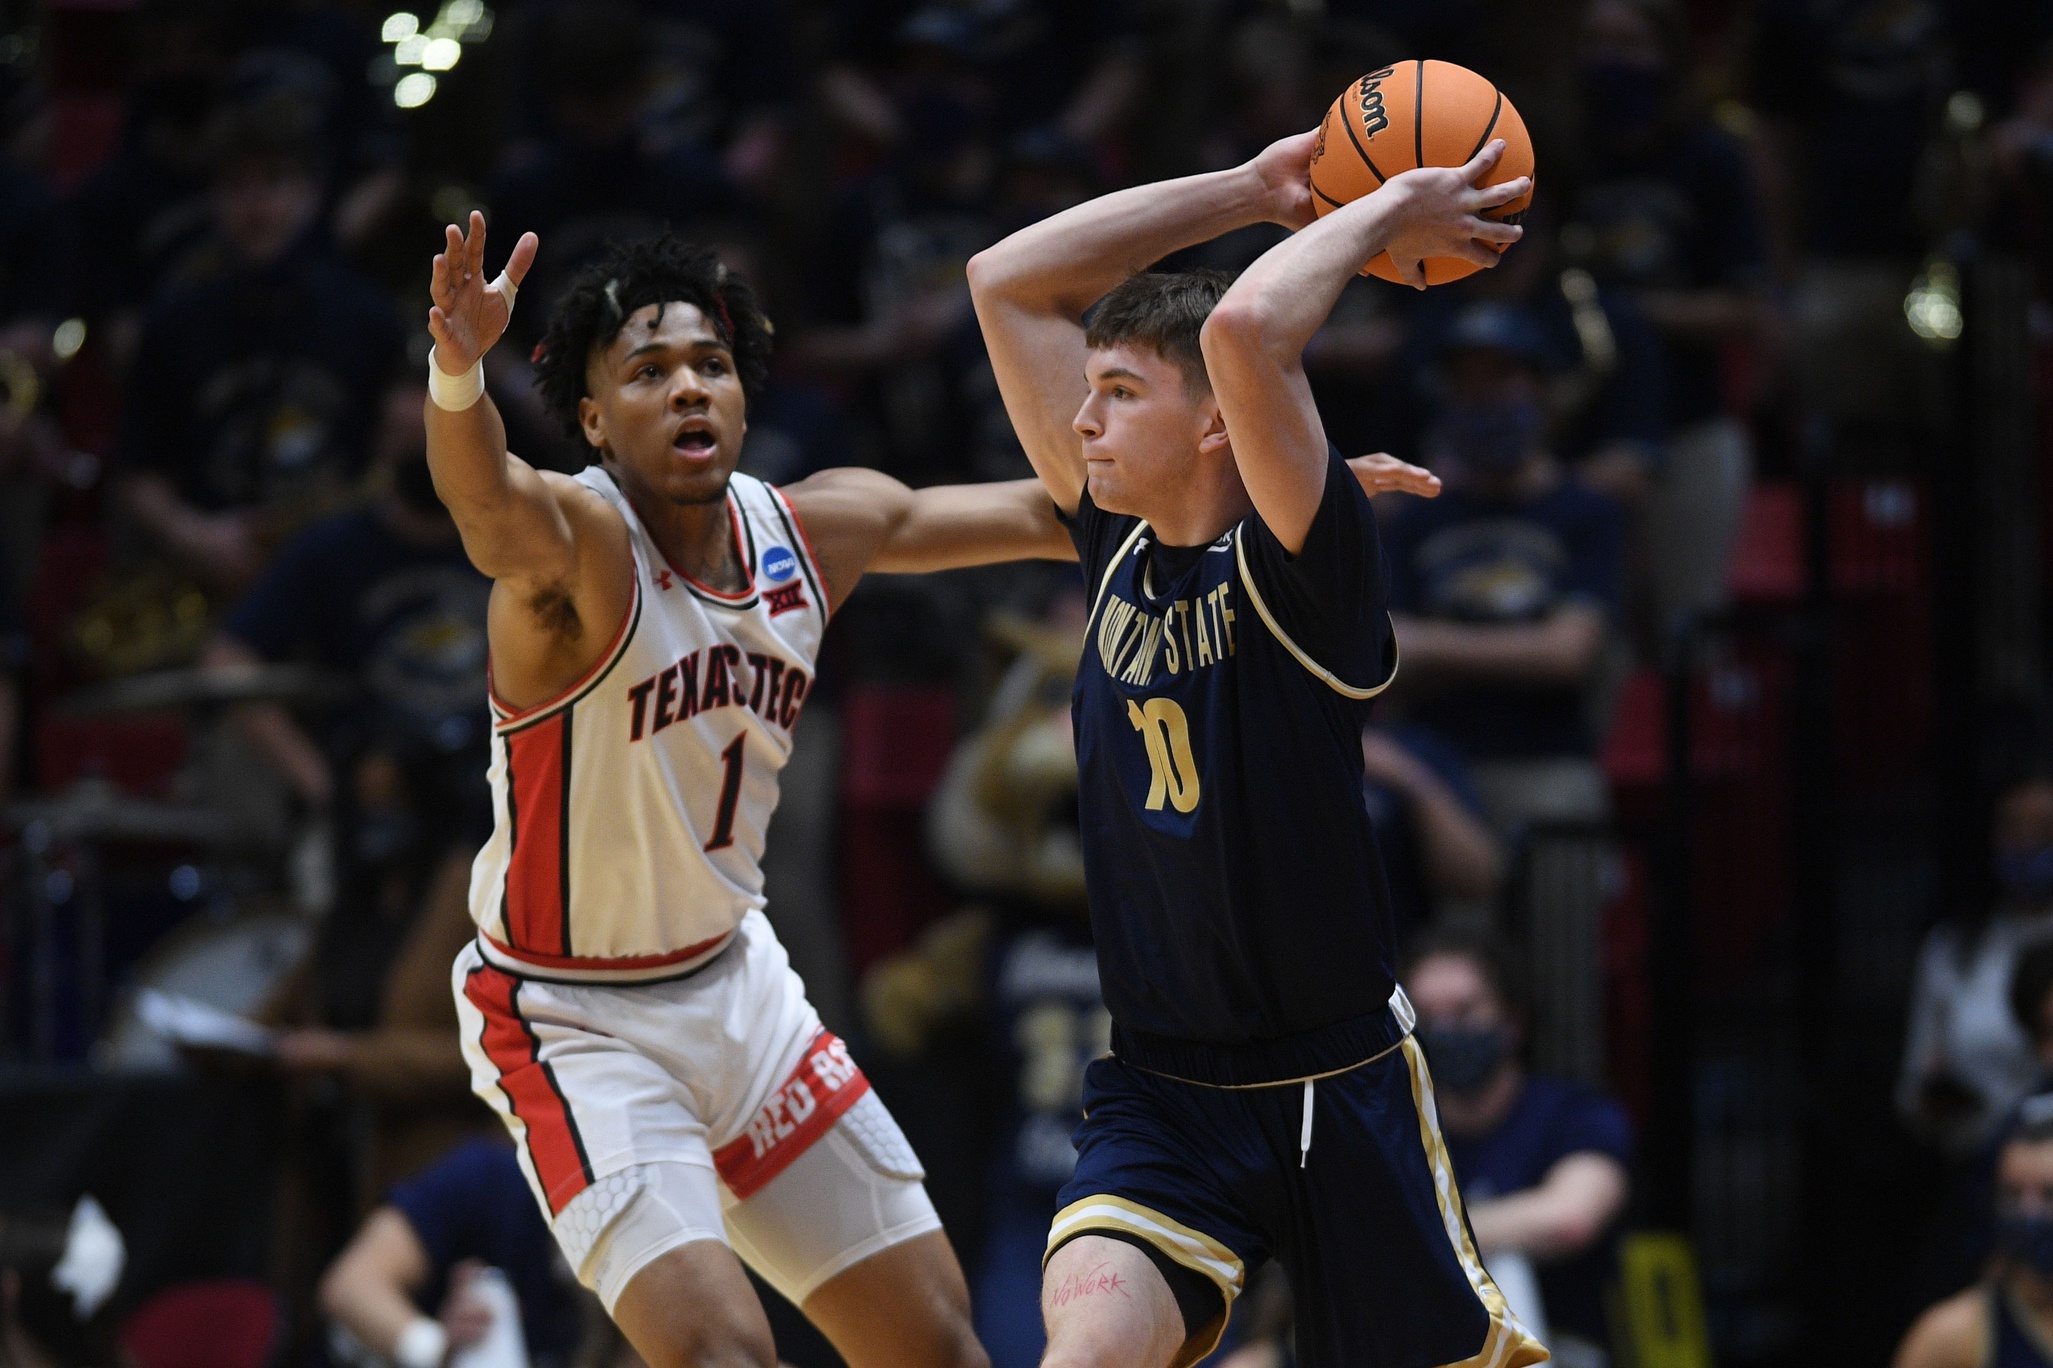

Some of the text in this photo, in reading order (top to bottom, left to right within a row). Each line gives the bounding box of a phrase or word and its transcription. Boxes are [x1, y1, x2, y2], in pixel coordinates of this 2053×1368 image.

[1360, 67, 1396, 142] lson
[1163, 581, 1237, 676] STATE
[627, 643, 816, 743] TEXAS TEC
[703, 729, 748, 853] 1
[1126, 697, 1200, 813] 10
[749, 1077, 817, 1160] RED
